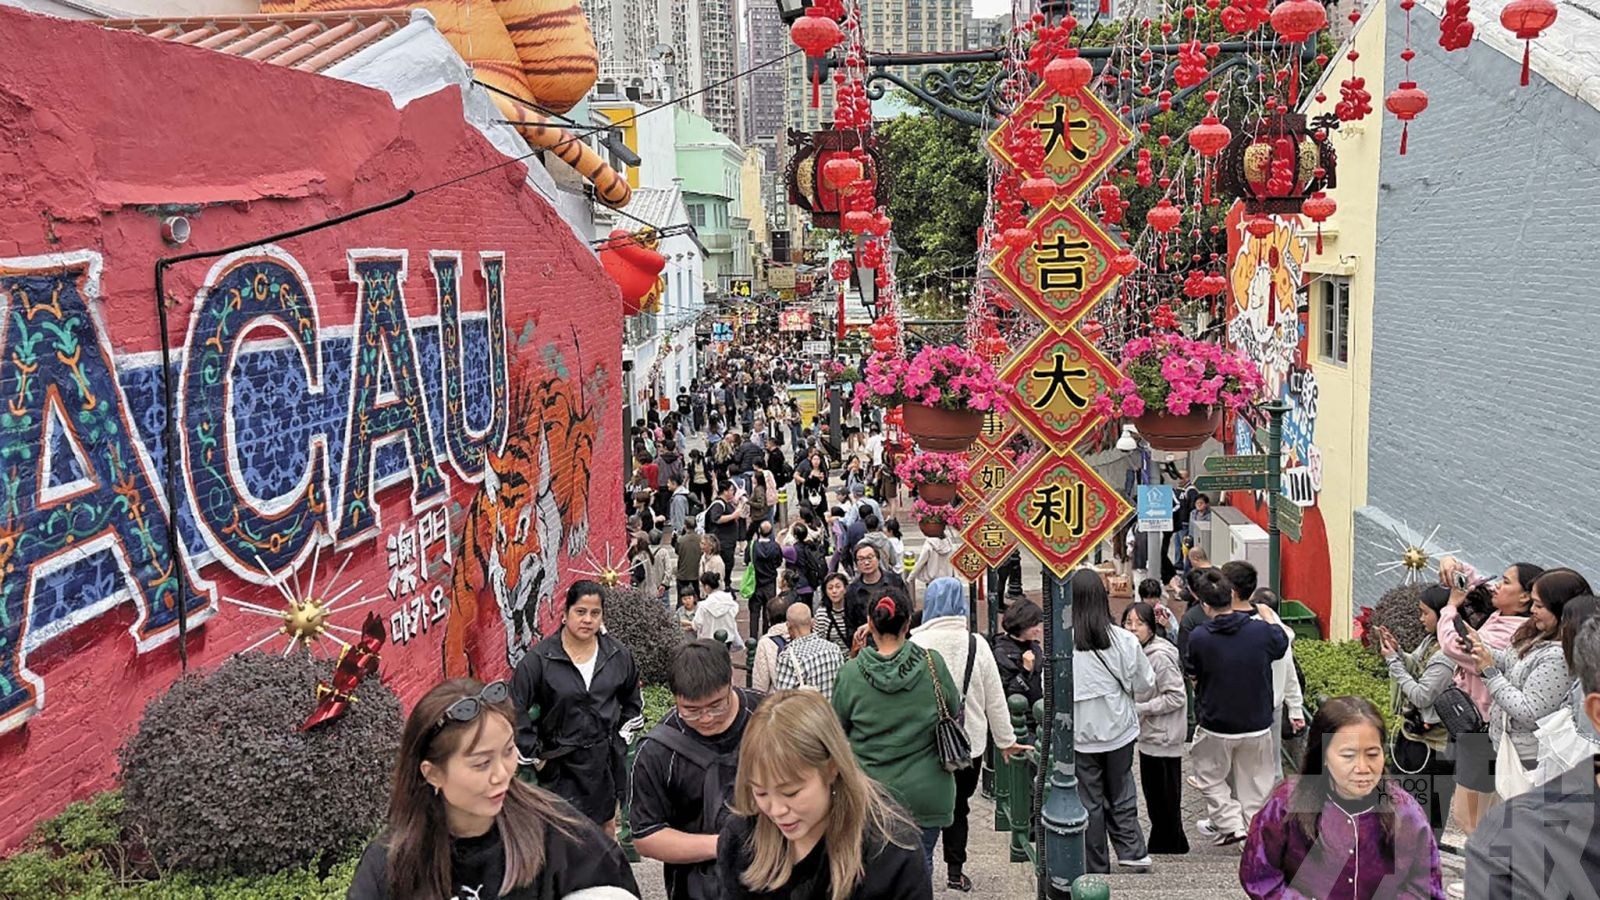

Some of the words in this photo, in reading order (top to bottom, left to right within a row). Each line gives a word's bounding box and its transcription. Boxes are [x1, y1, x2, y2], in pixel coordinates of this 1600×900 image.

[1031, 104, 1089, 538] 大吉大利
[387, 505, 452, 600] 澳門
[391, 585, 447, 646] 마카오
